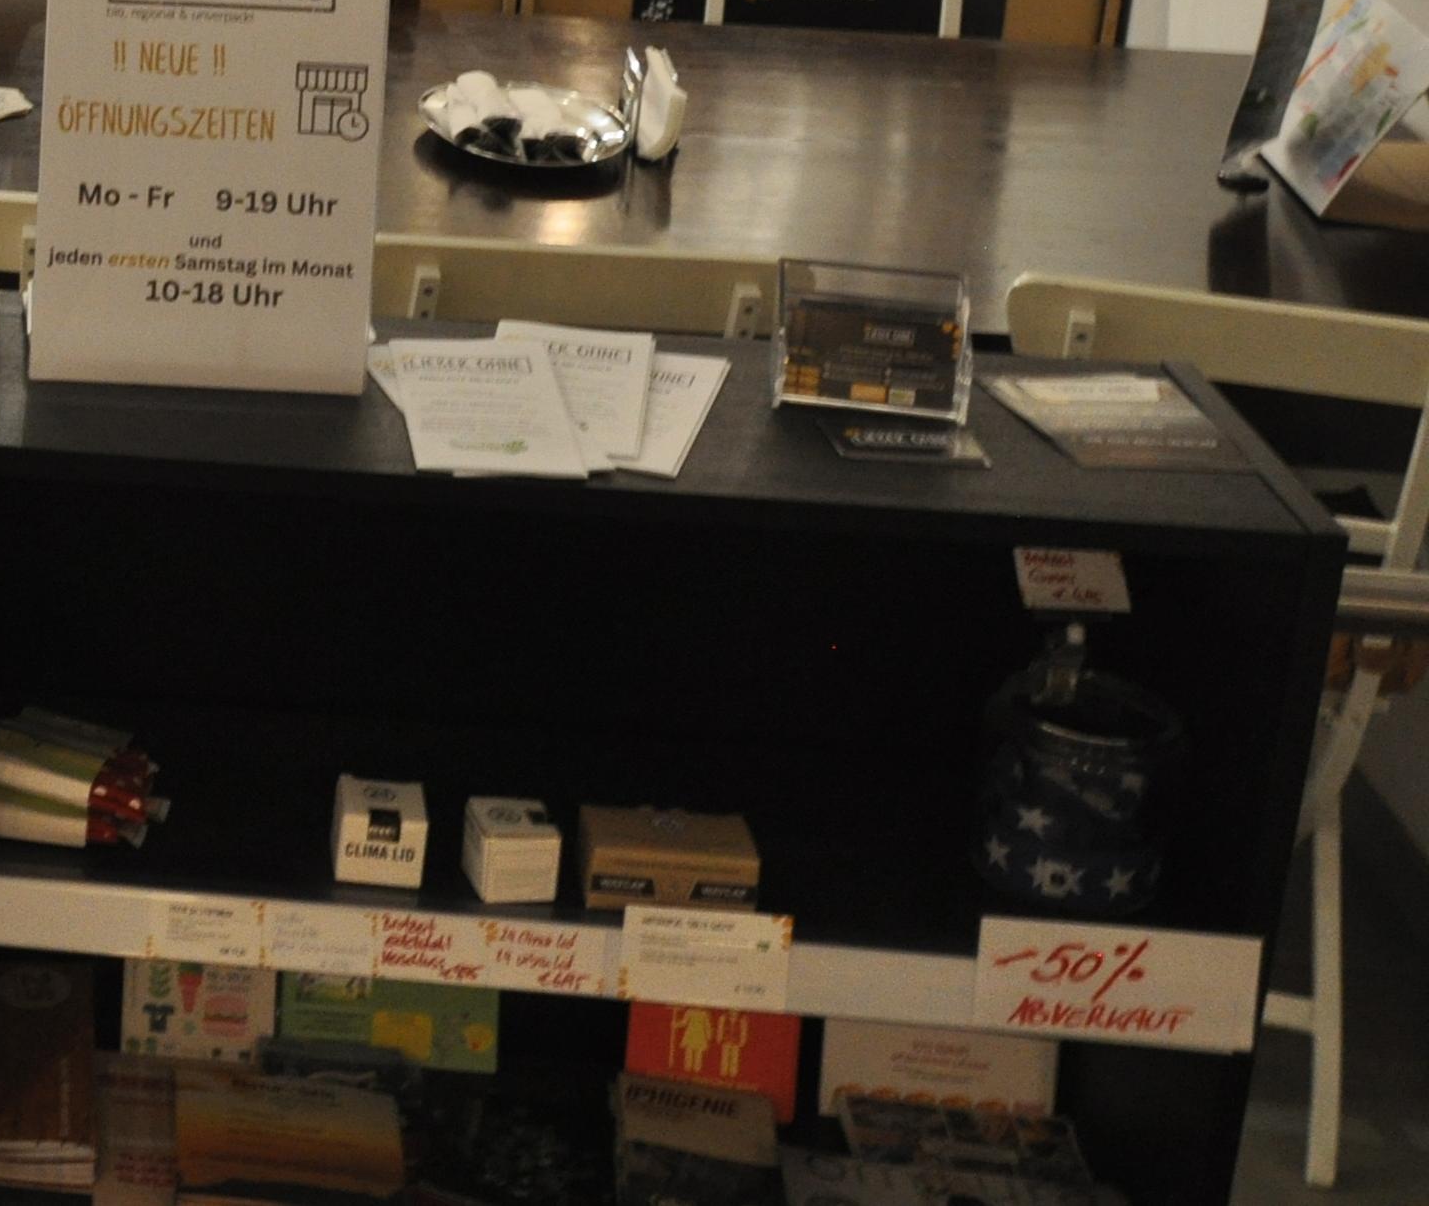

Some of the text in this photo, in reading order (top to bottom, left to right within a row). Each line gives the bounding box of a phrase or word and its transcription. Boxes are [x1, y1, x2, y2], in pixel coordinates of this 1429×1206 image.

[140, 42, 200, 76] NEUE
[58, 96, 276, 142] ÖFFNUNGSZEITEN
[78, 183, 121, 207] Mo
[147, 185, 175, 209] Fr
[215, 189, 278, 214] 9-19
[287, 192, 338, 216] Uhr
[189, 234, 223, 249] und
[47, 246, 354, 279] jeden ersten Samstag im Monat
[145, 280, 284, 307] 10-18 Uhr
[344, 842, 416, 863] CLIMA LID
[994, 940, 1149, 1001] -50%
[1008, 996, 1195, 1036] ABVERKAUF
